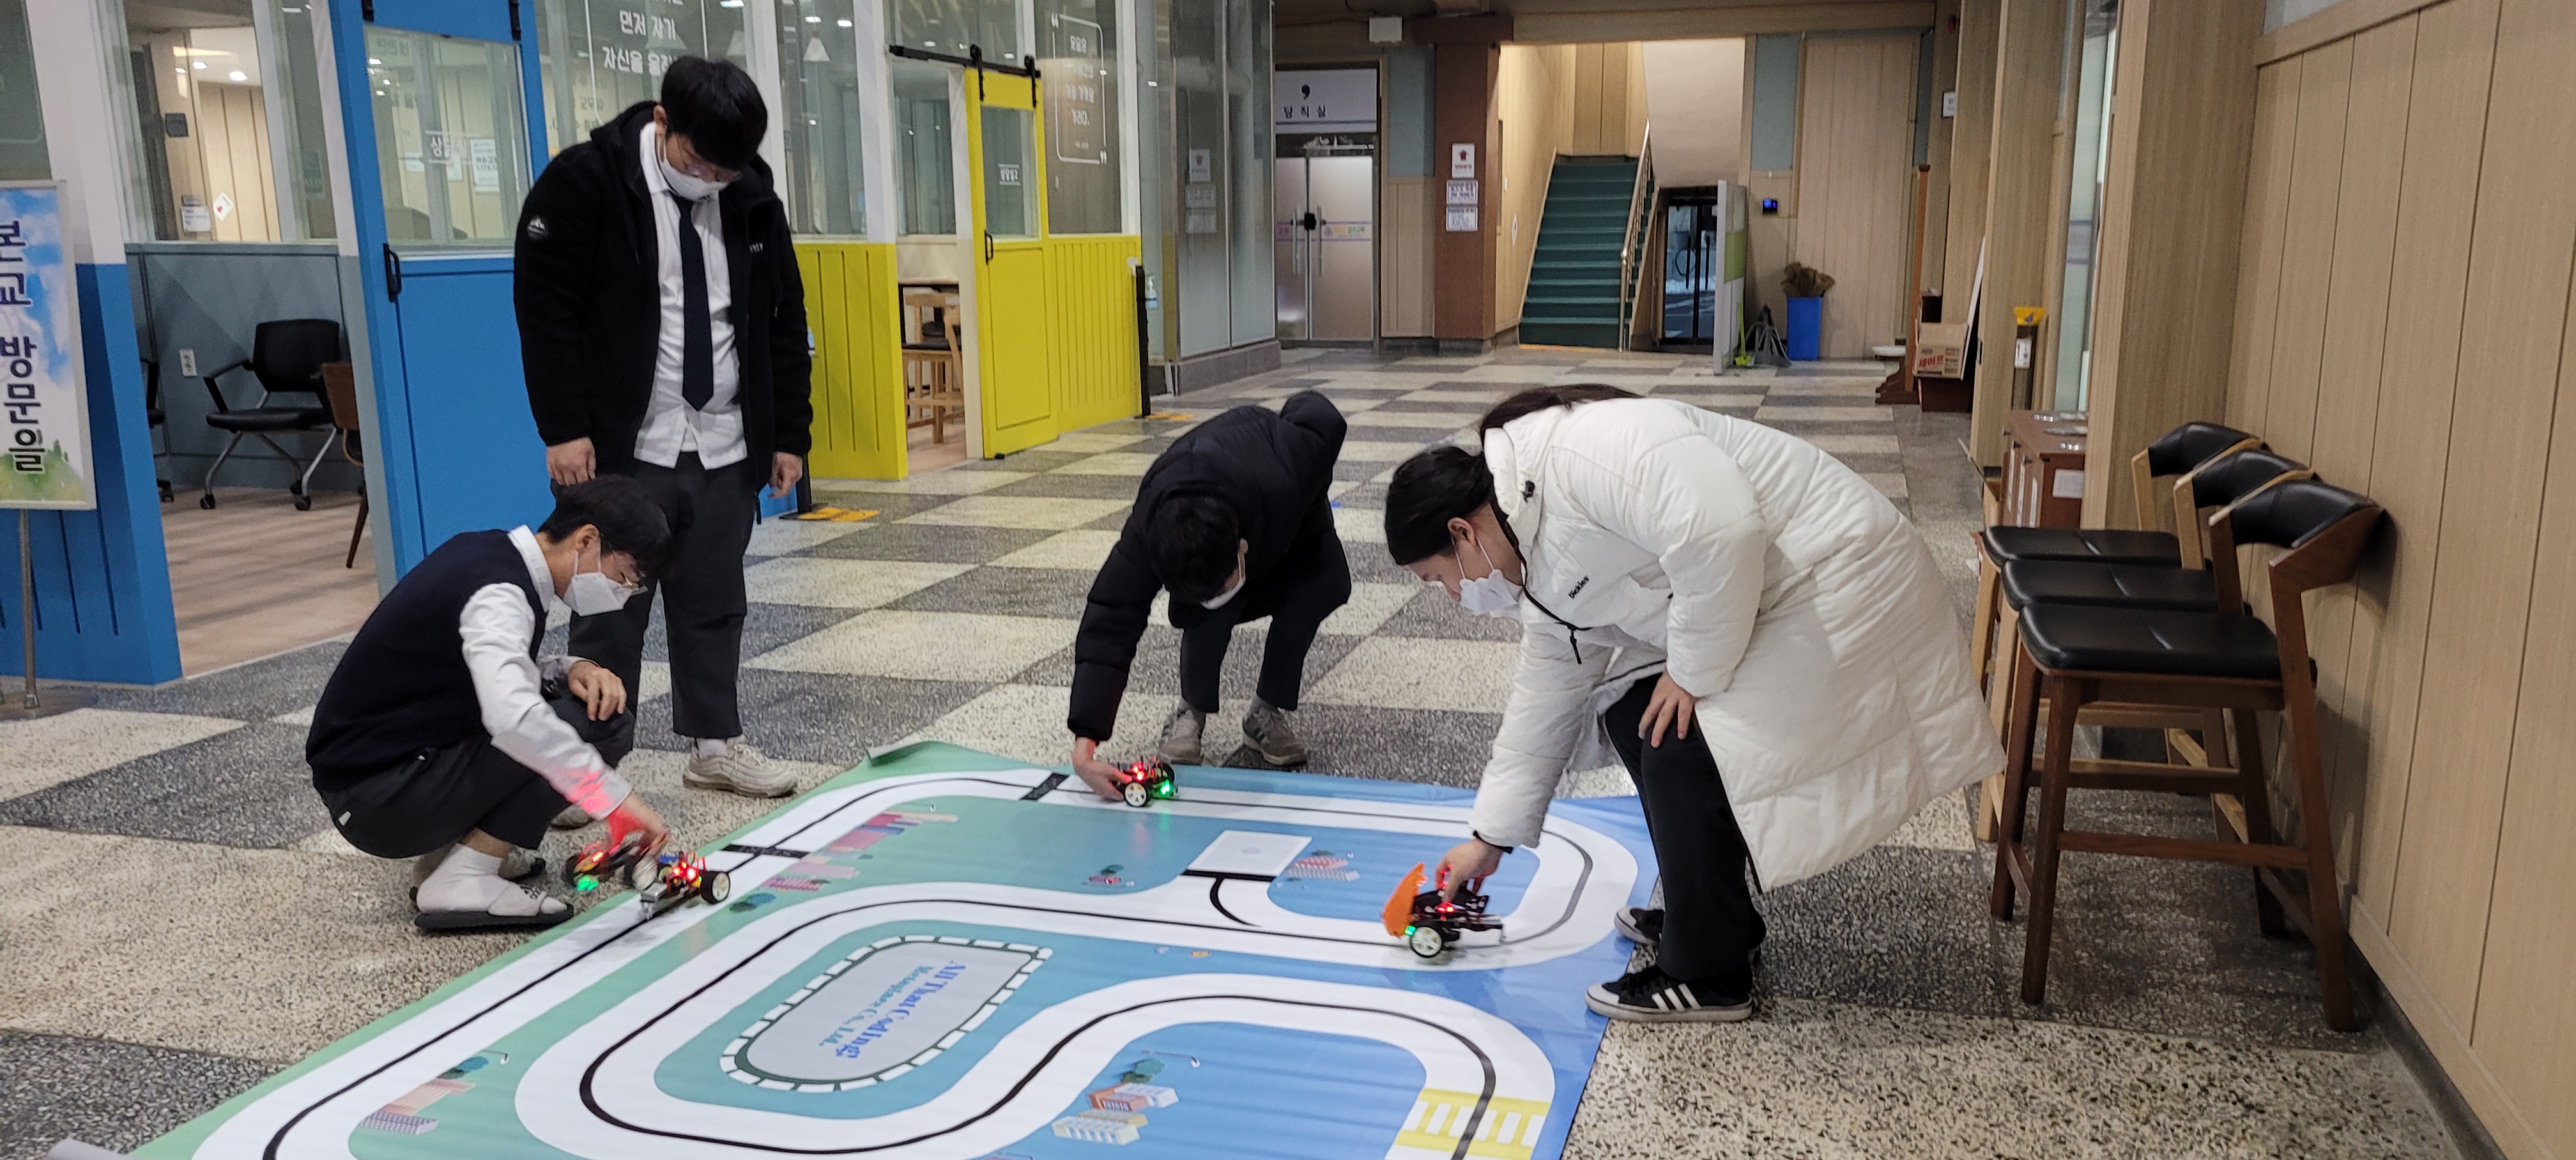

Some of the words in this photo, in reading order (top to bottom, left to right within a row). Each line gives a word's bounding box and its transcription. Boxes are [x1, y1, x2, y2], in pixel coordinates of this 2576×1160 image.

[619, 10, 646, 36] 먼저
[650, 15, 677, 41] 자기
[602, 47, 643, 74] 자신을
[0, 336, 46, 472] 방문을
[1568, 575, 1590, 599] Dickies
[836, 1009, 910, 1058] Coding
